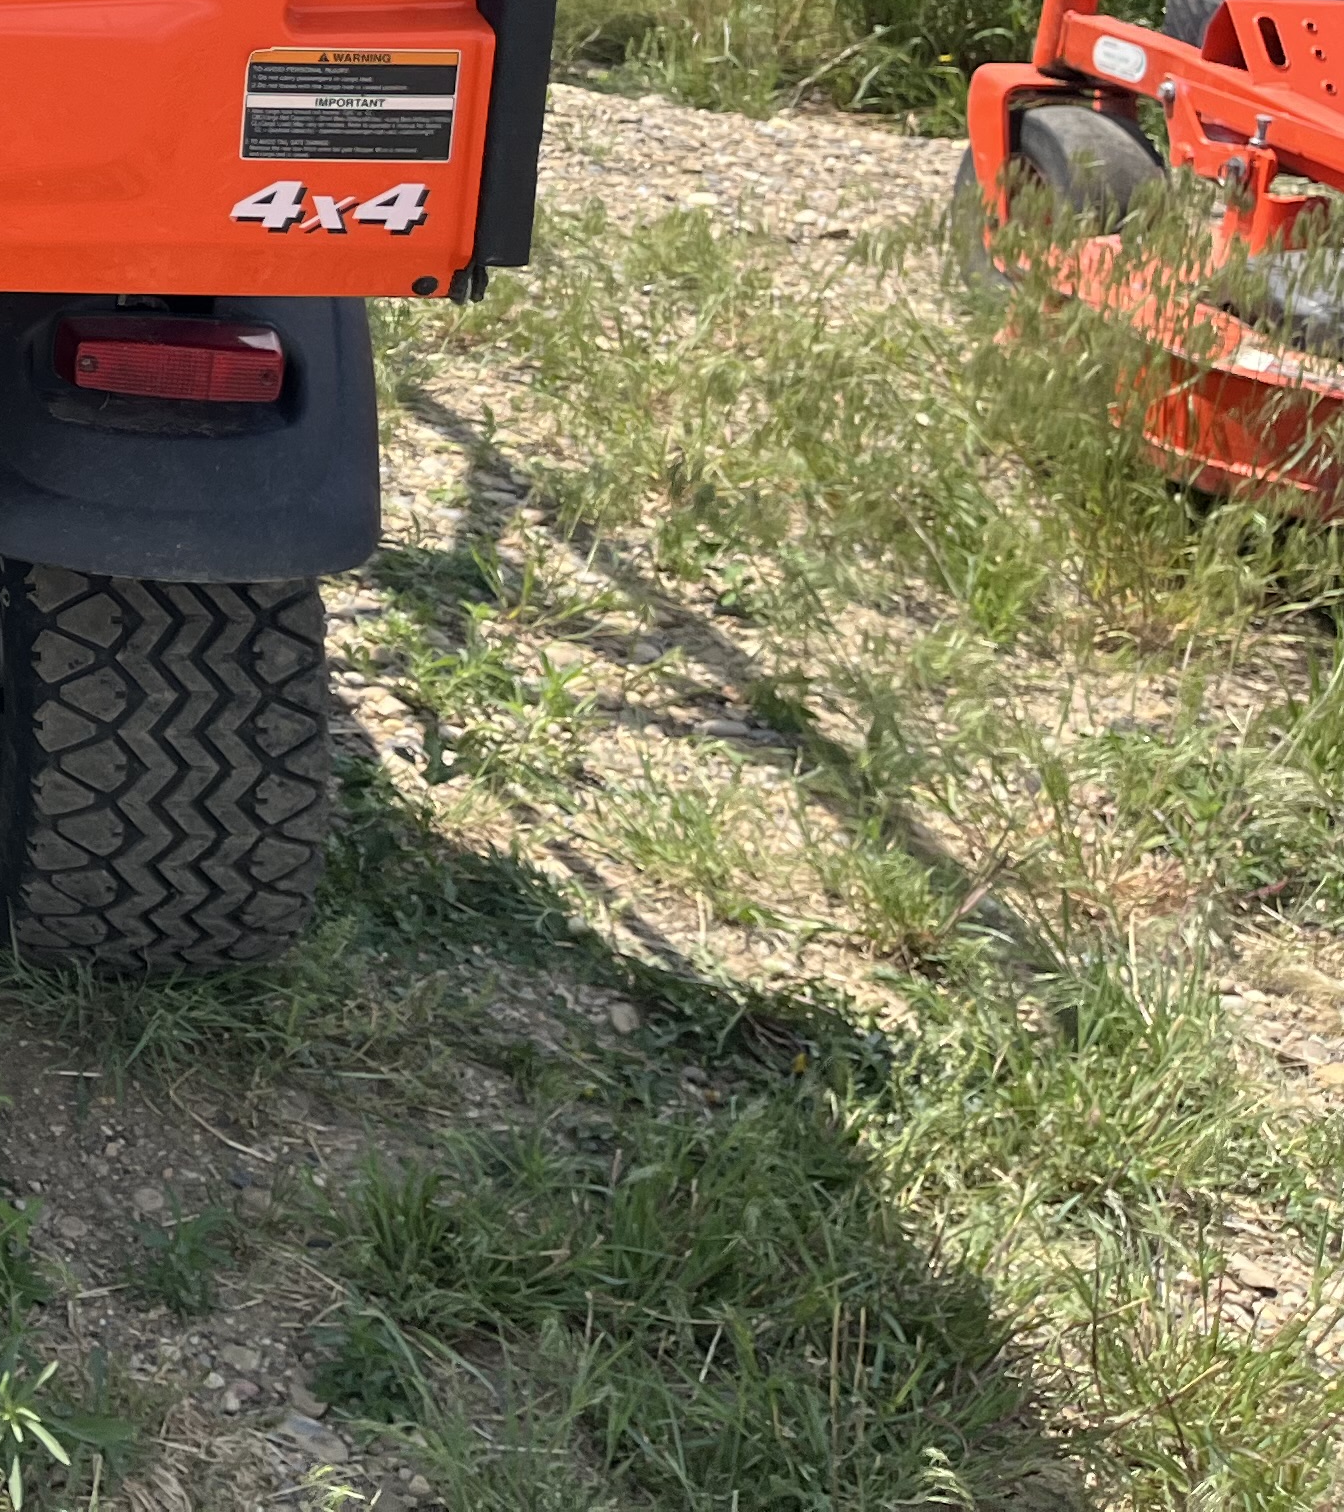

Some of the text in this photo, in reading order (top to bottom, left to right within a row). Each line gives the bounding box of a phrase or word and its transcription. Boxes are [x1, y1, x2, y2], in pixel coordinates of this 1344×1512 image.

[332, 53, 392, 64] WARNING
[314, 97, 386, 108] IMPORTANT
[229, 180, 431, 236] 4x4
